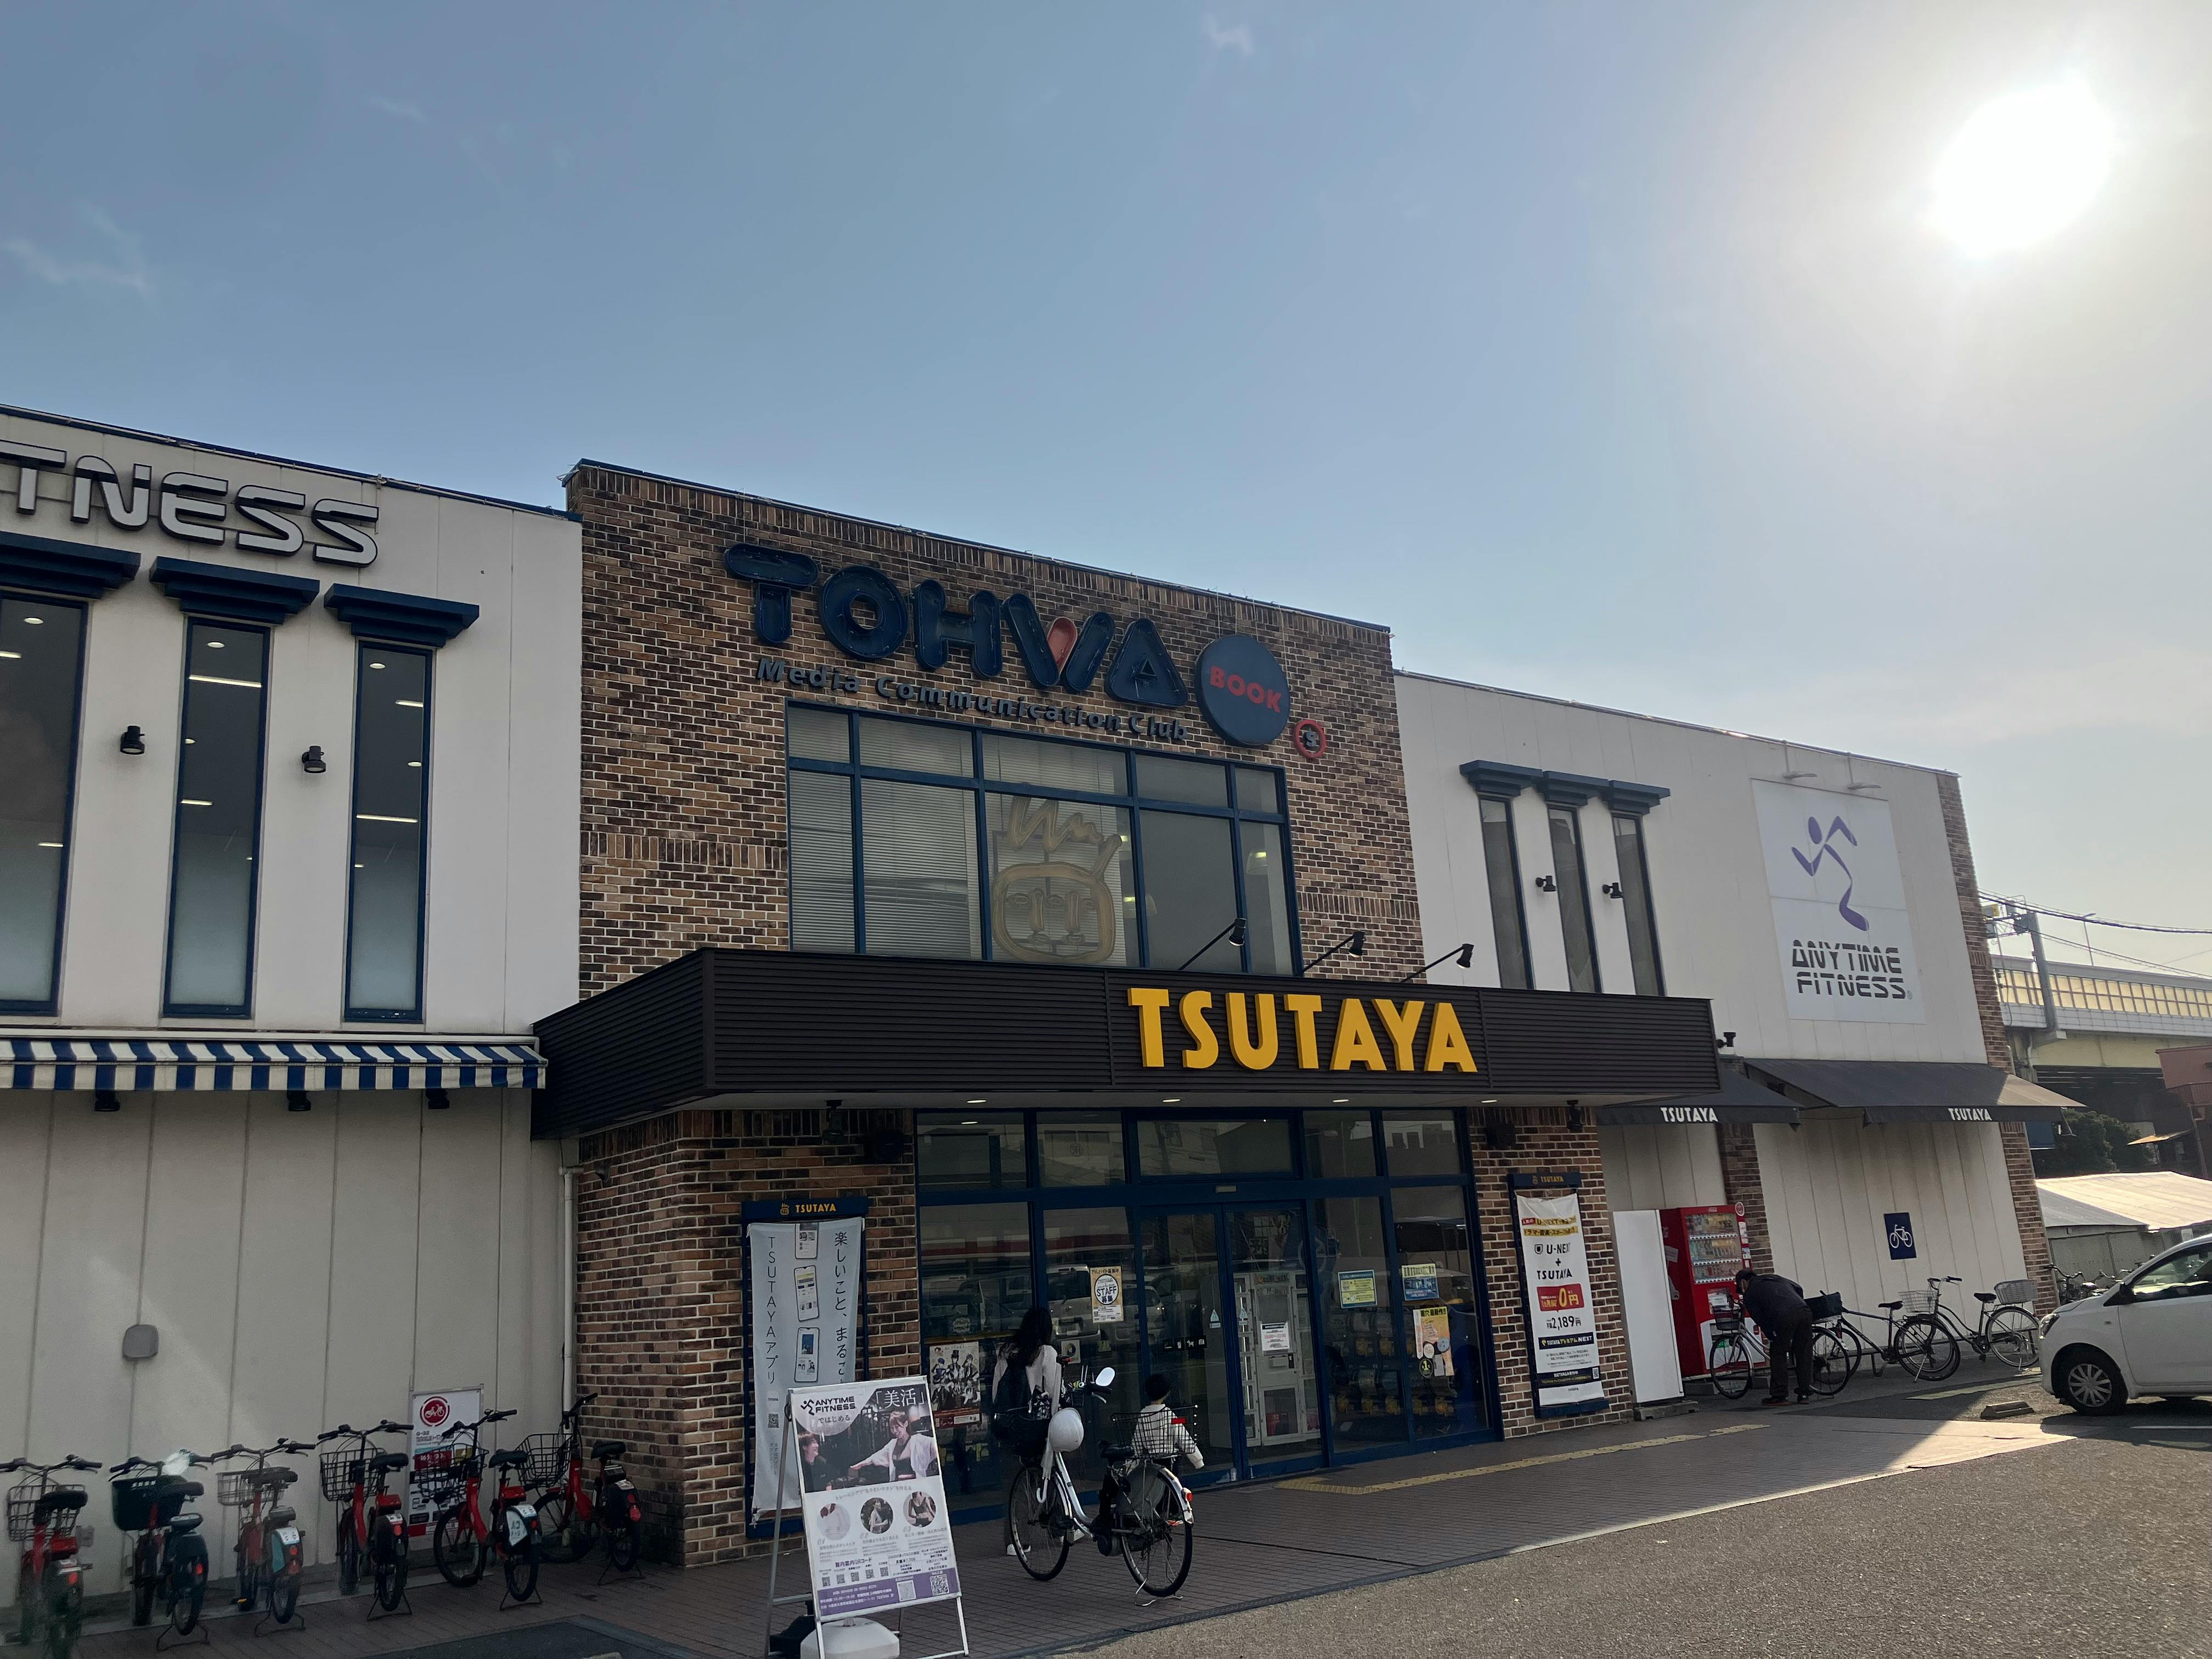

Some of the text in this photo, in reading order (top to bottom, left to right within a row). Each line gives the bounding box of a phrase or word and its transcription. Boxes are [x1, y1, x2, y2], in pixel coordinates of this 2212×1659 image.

[724, 543, 1188, 708] TOHWA
[1209, 665, 1282, 713] BOOK
[757, 658, 1189, 741] Media Communication Club
[1792, 939, 1903, 974] ANYTIME
[1797, 971, 1906, 1000] FITNESS
[1127, 987, 1478, 1073] TSUTAYA
[1660, 1107, 1718, 1122] TSUTAYA
[1948, 1108, 1993, 1121] TSUTAYA
[1541, 1175, 1564, 1183] TSUTAYA
[795, 1203, 837, 1213] TSUTAYA
[1097, 1285, 1117, 1297] STAFF
[815, 1396, 855, 1406] ANYTIME
[816, 1402, 856, 1413] FITNESS
[818, 1415, 850, 1423] ではじめる
